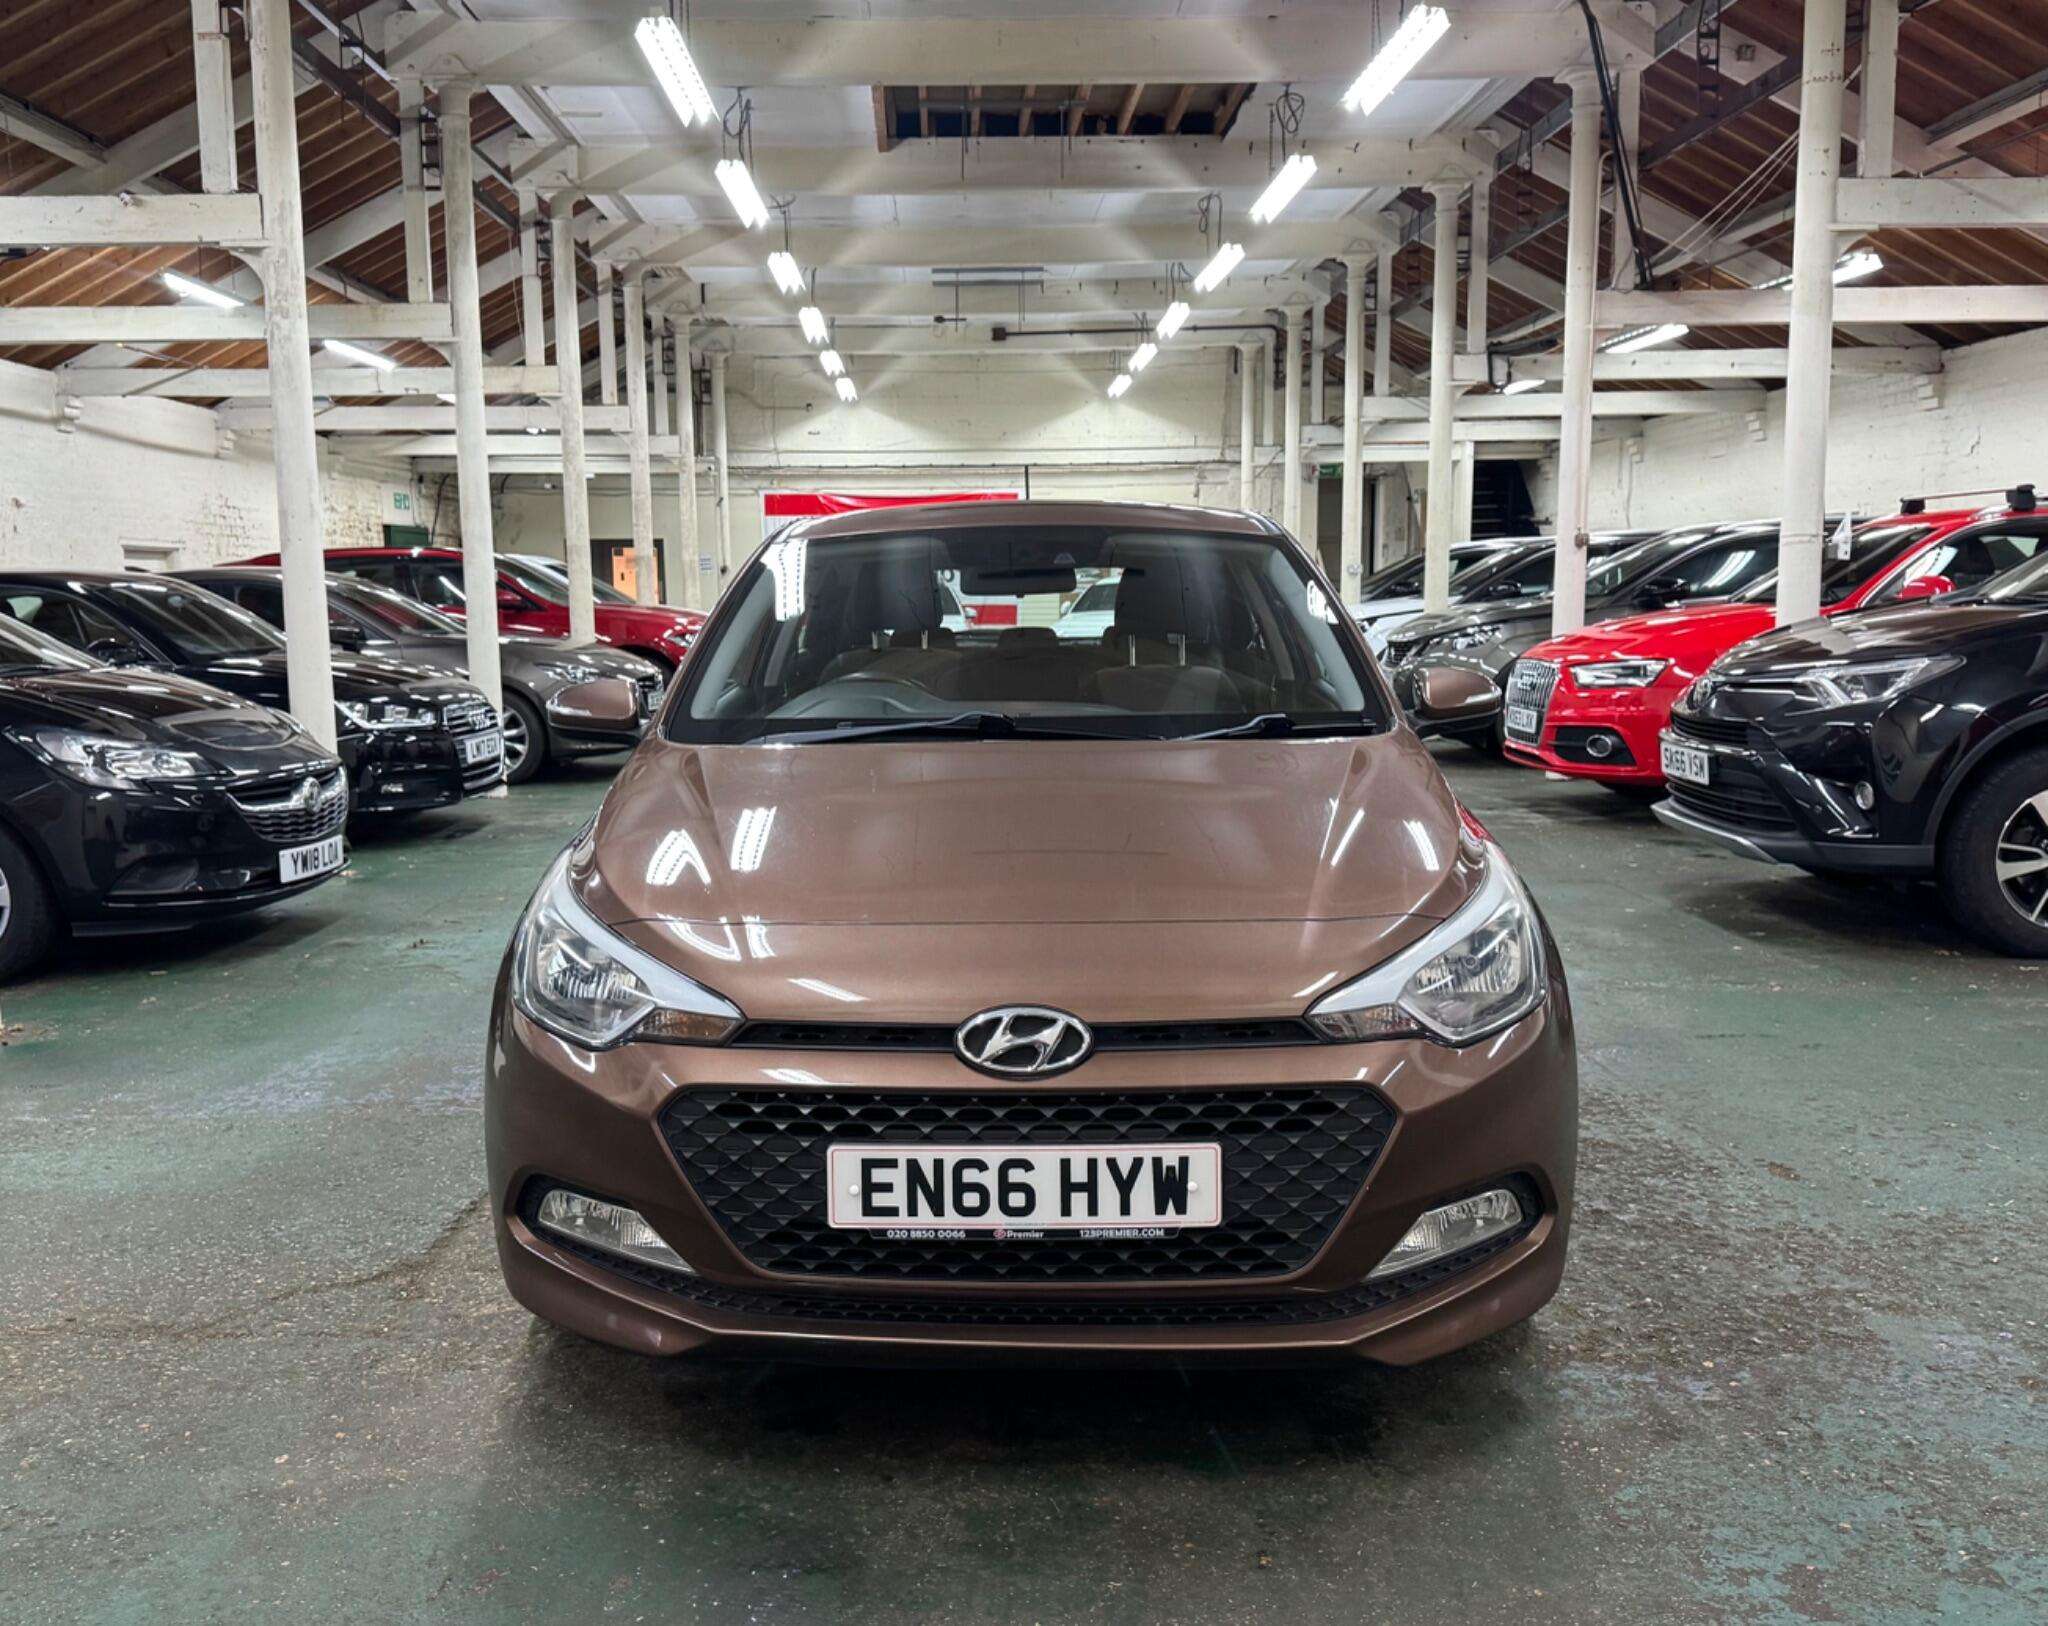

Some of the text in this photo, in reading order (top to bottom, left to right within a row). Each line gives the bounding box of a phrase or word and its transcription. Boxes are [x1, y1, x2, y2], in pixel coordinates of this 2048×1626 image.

[861, 1156, 1189, 1218] EN66 HYW
[887, 1229, 966, 1239] 020 8850 0066
[1006, 1229, 1045, 1239] Premier
[1079, 1228, 1165, 1239] 123PREMIER.COM
